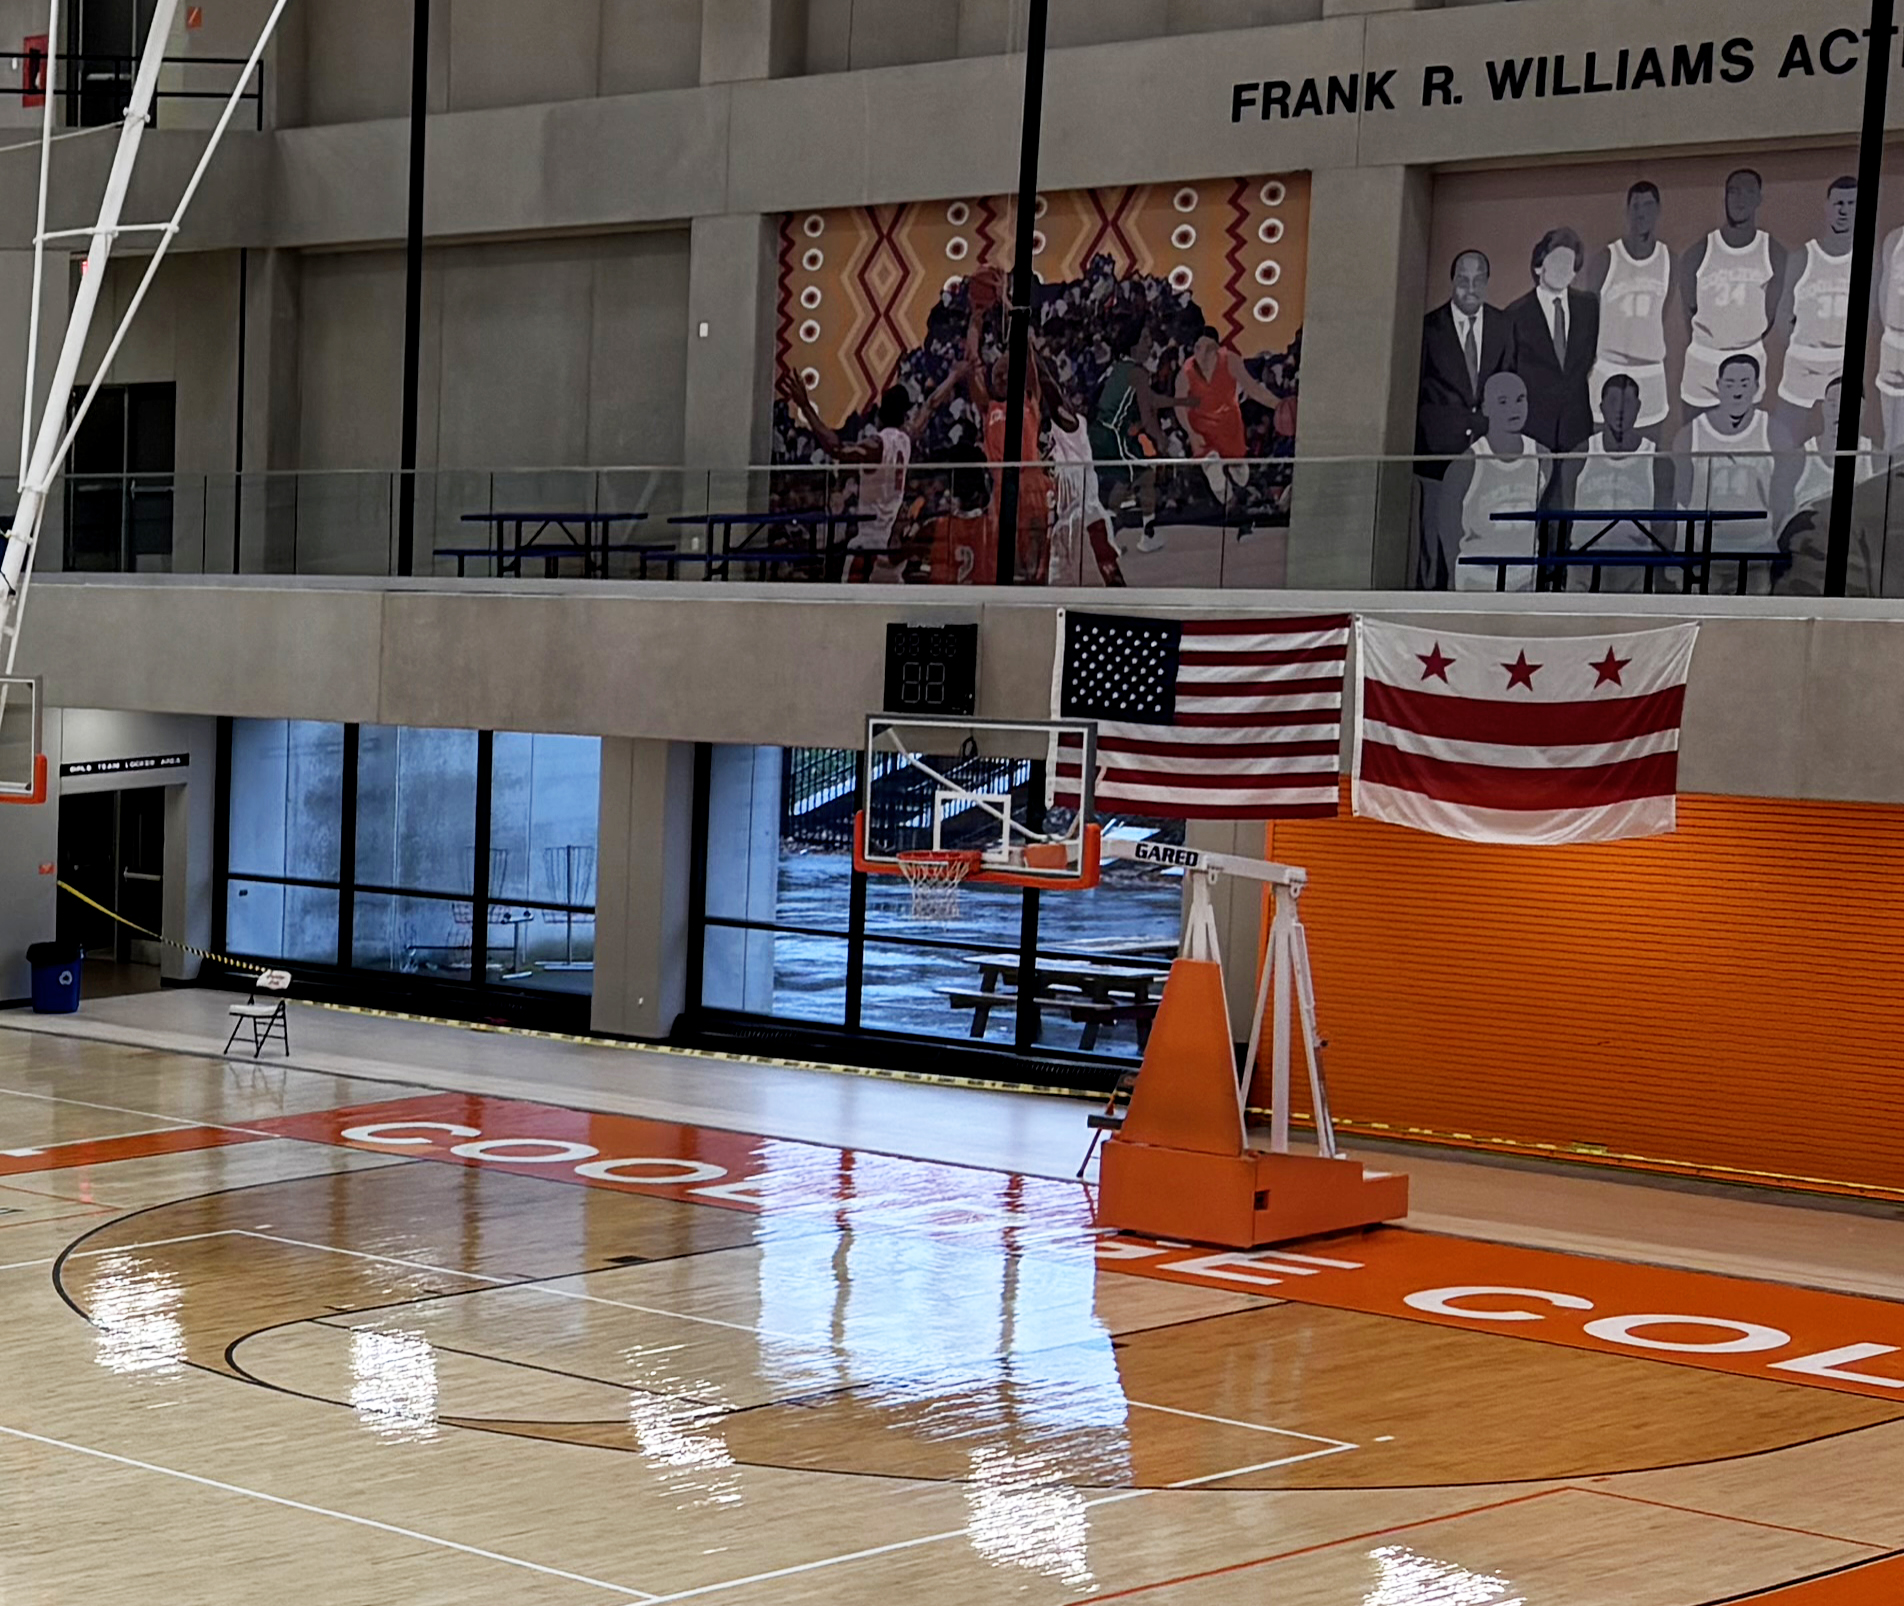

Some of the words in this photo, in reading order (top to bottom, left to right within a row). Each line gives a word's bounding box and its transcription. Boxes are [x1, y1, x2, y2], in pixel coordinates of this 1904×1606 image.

[1230, 69, 1398, 123] FRANK
[1421, 65, 1464, 106] R.
[1485, 37, 1755, 101] WILLIAMS
[1134, 842, 1199, 867] GARED
